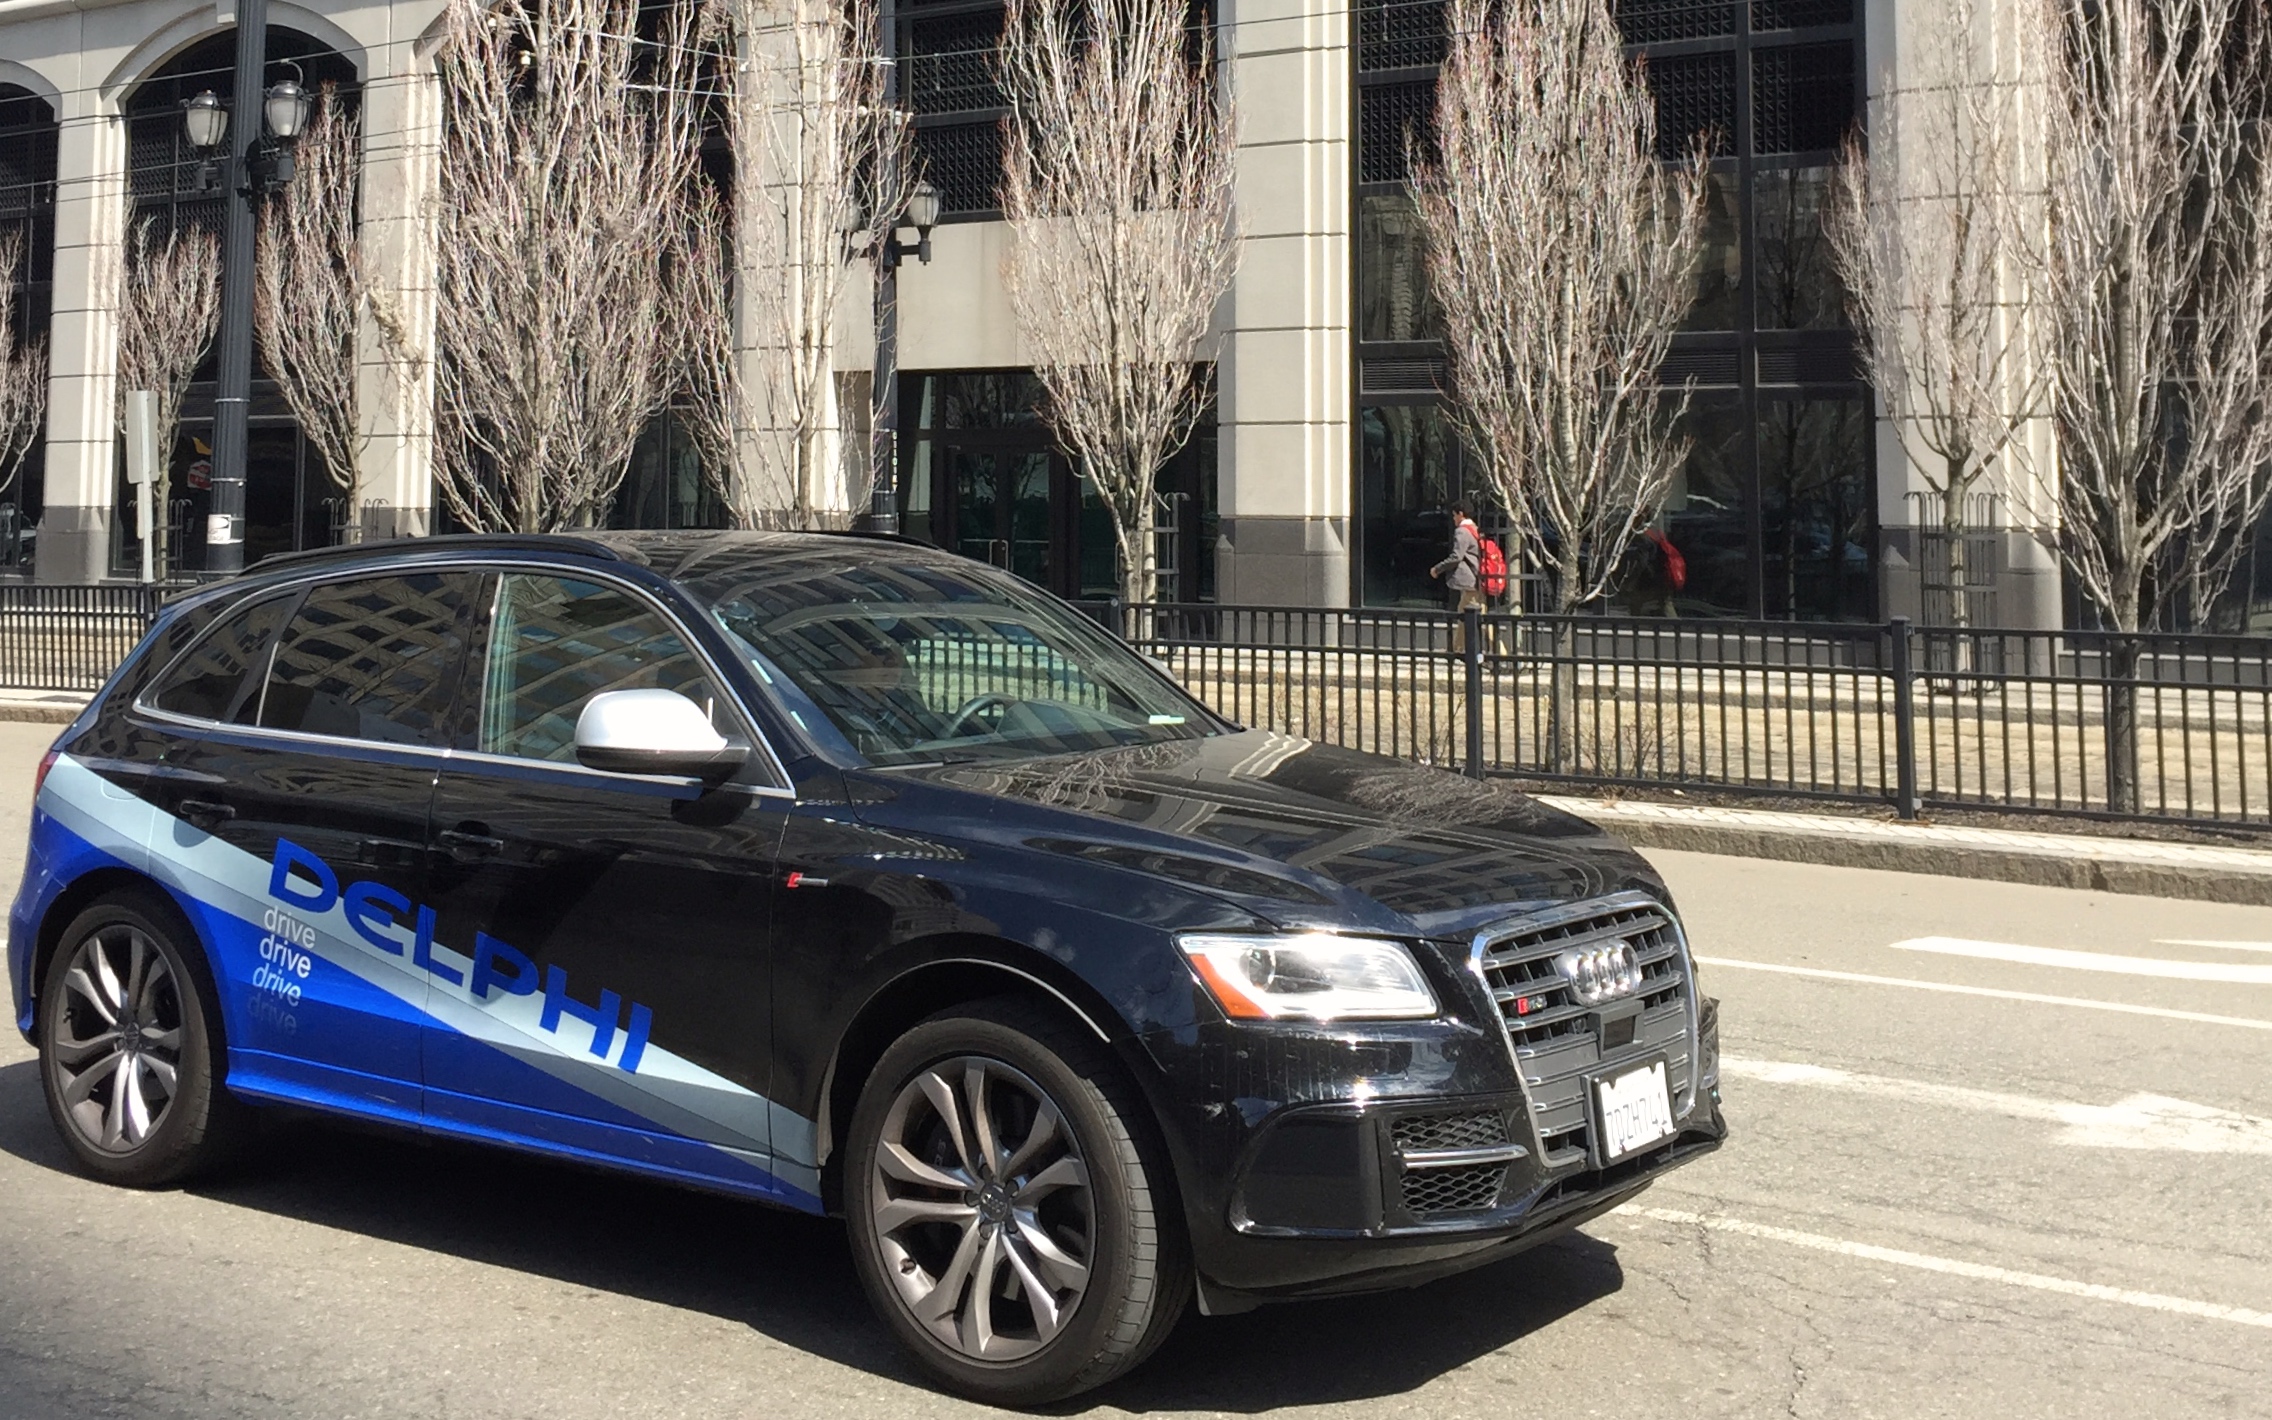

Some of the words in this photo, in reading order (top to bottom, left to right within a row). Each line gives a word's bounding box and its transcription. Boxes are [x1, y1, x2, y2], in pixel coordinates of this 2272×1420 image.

[263, 905, 316, 949] drive
[259, 934, 312, 979] drive
[268, 837, 653, 1074] DELPHI
[252, 963, 302, 1007] drive
